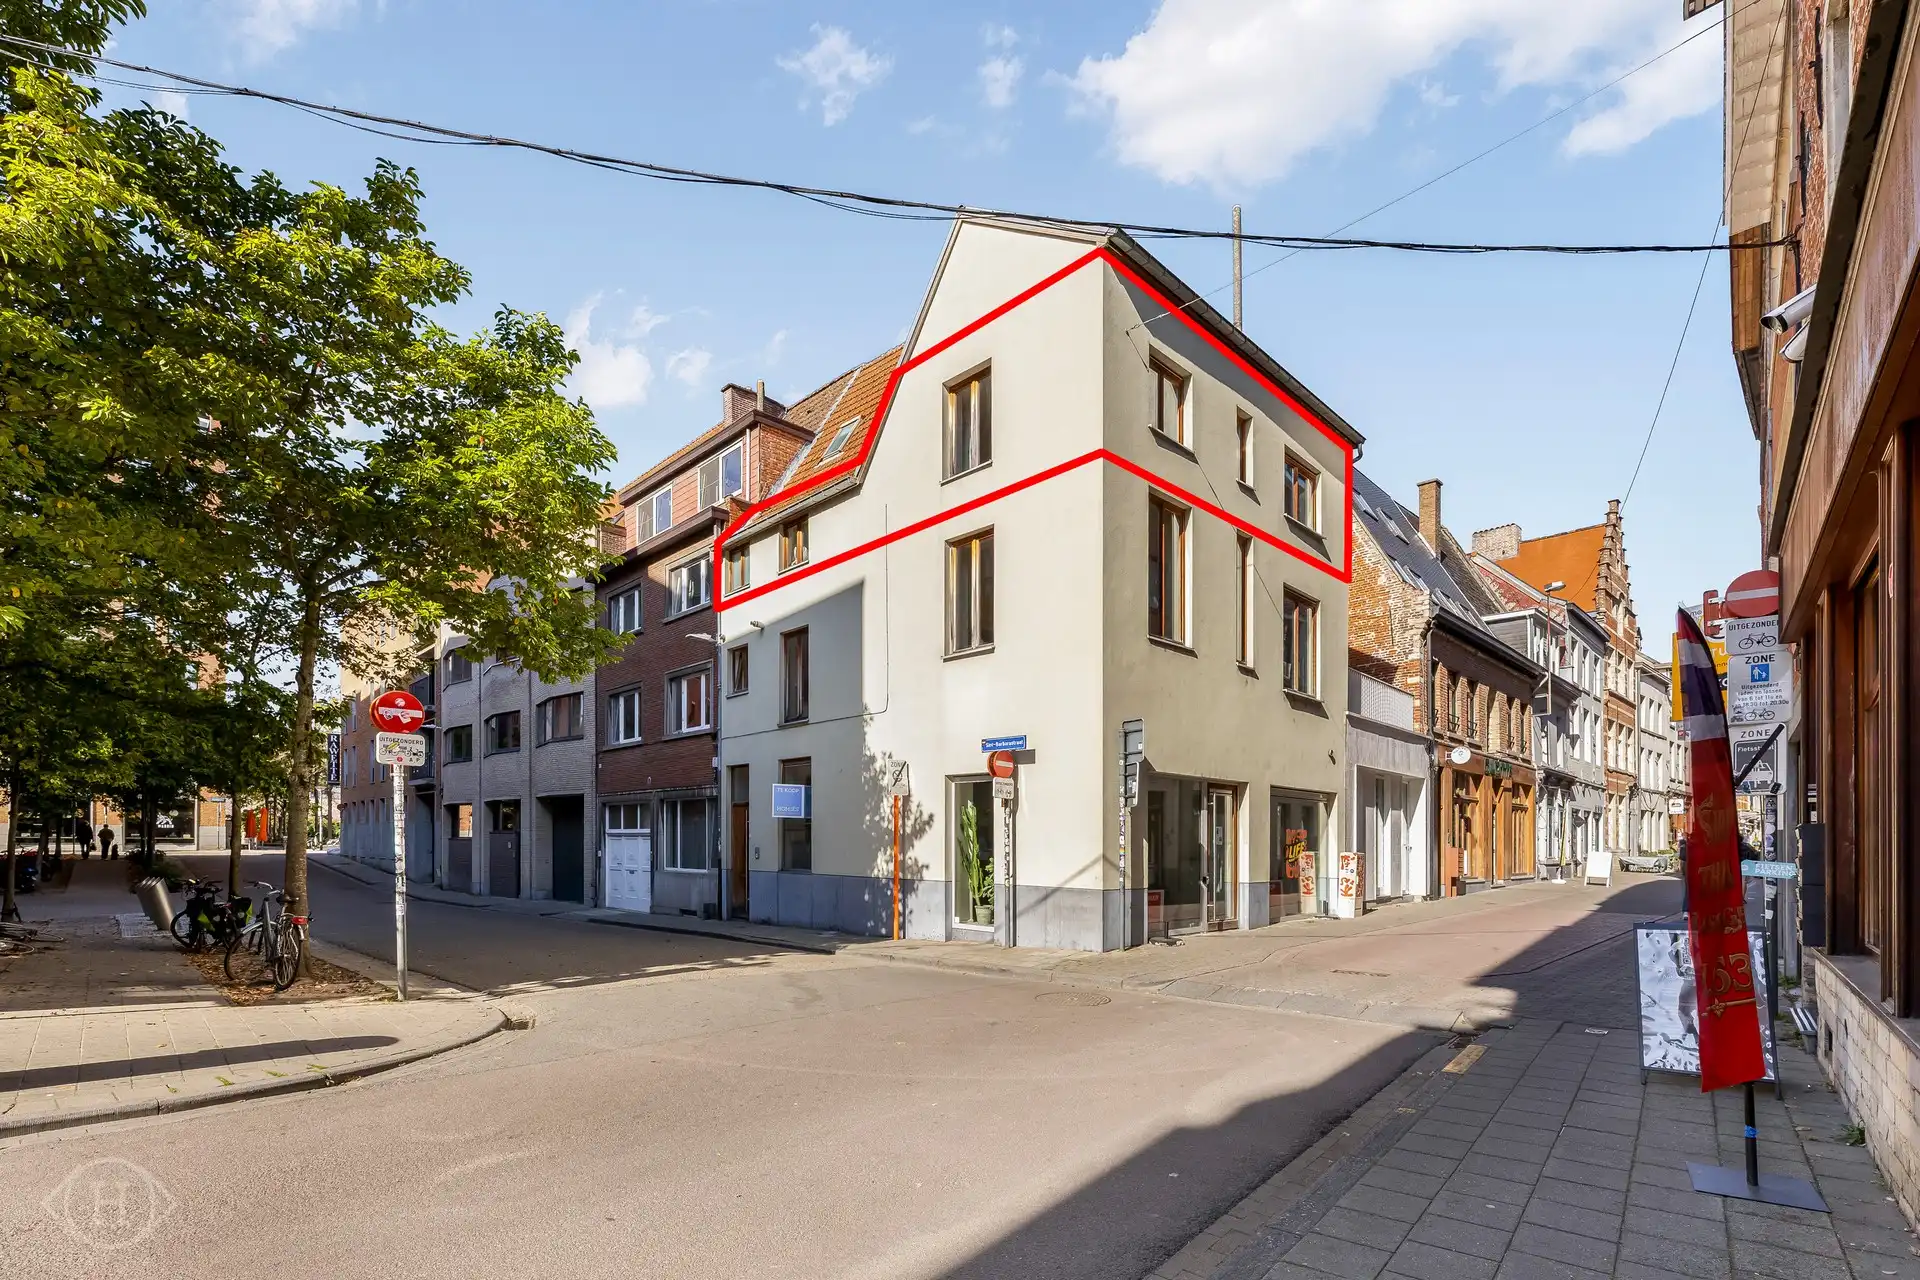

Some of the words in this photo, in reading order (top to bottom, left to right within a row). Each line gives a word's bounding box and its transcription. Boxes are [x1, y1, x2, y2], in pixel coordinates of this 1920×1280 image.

[1728, 619, 1778, 631] UITGEZONDE
[1745, 653, 1776, 665] ZONE
[1741, 682, 1779, 690] Uitgezonderd
[1740, 729, 1771, 739] ZONE
[379, 736, 424, 746] UITGEZONDERD
